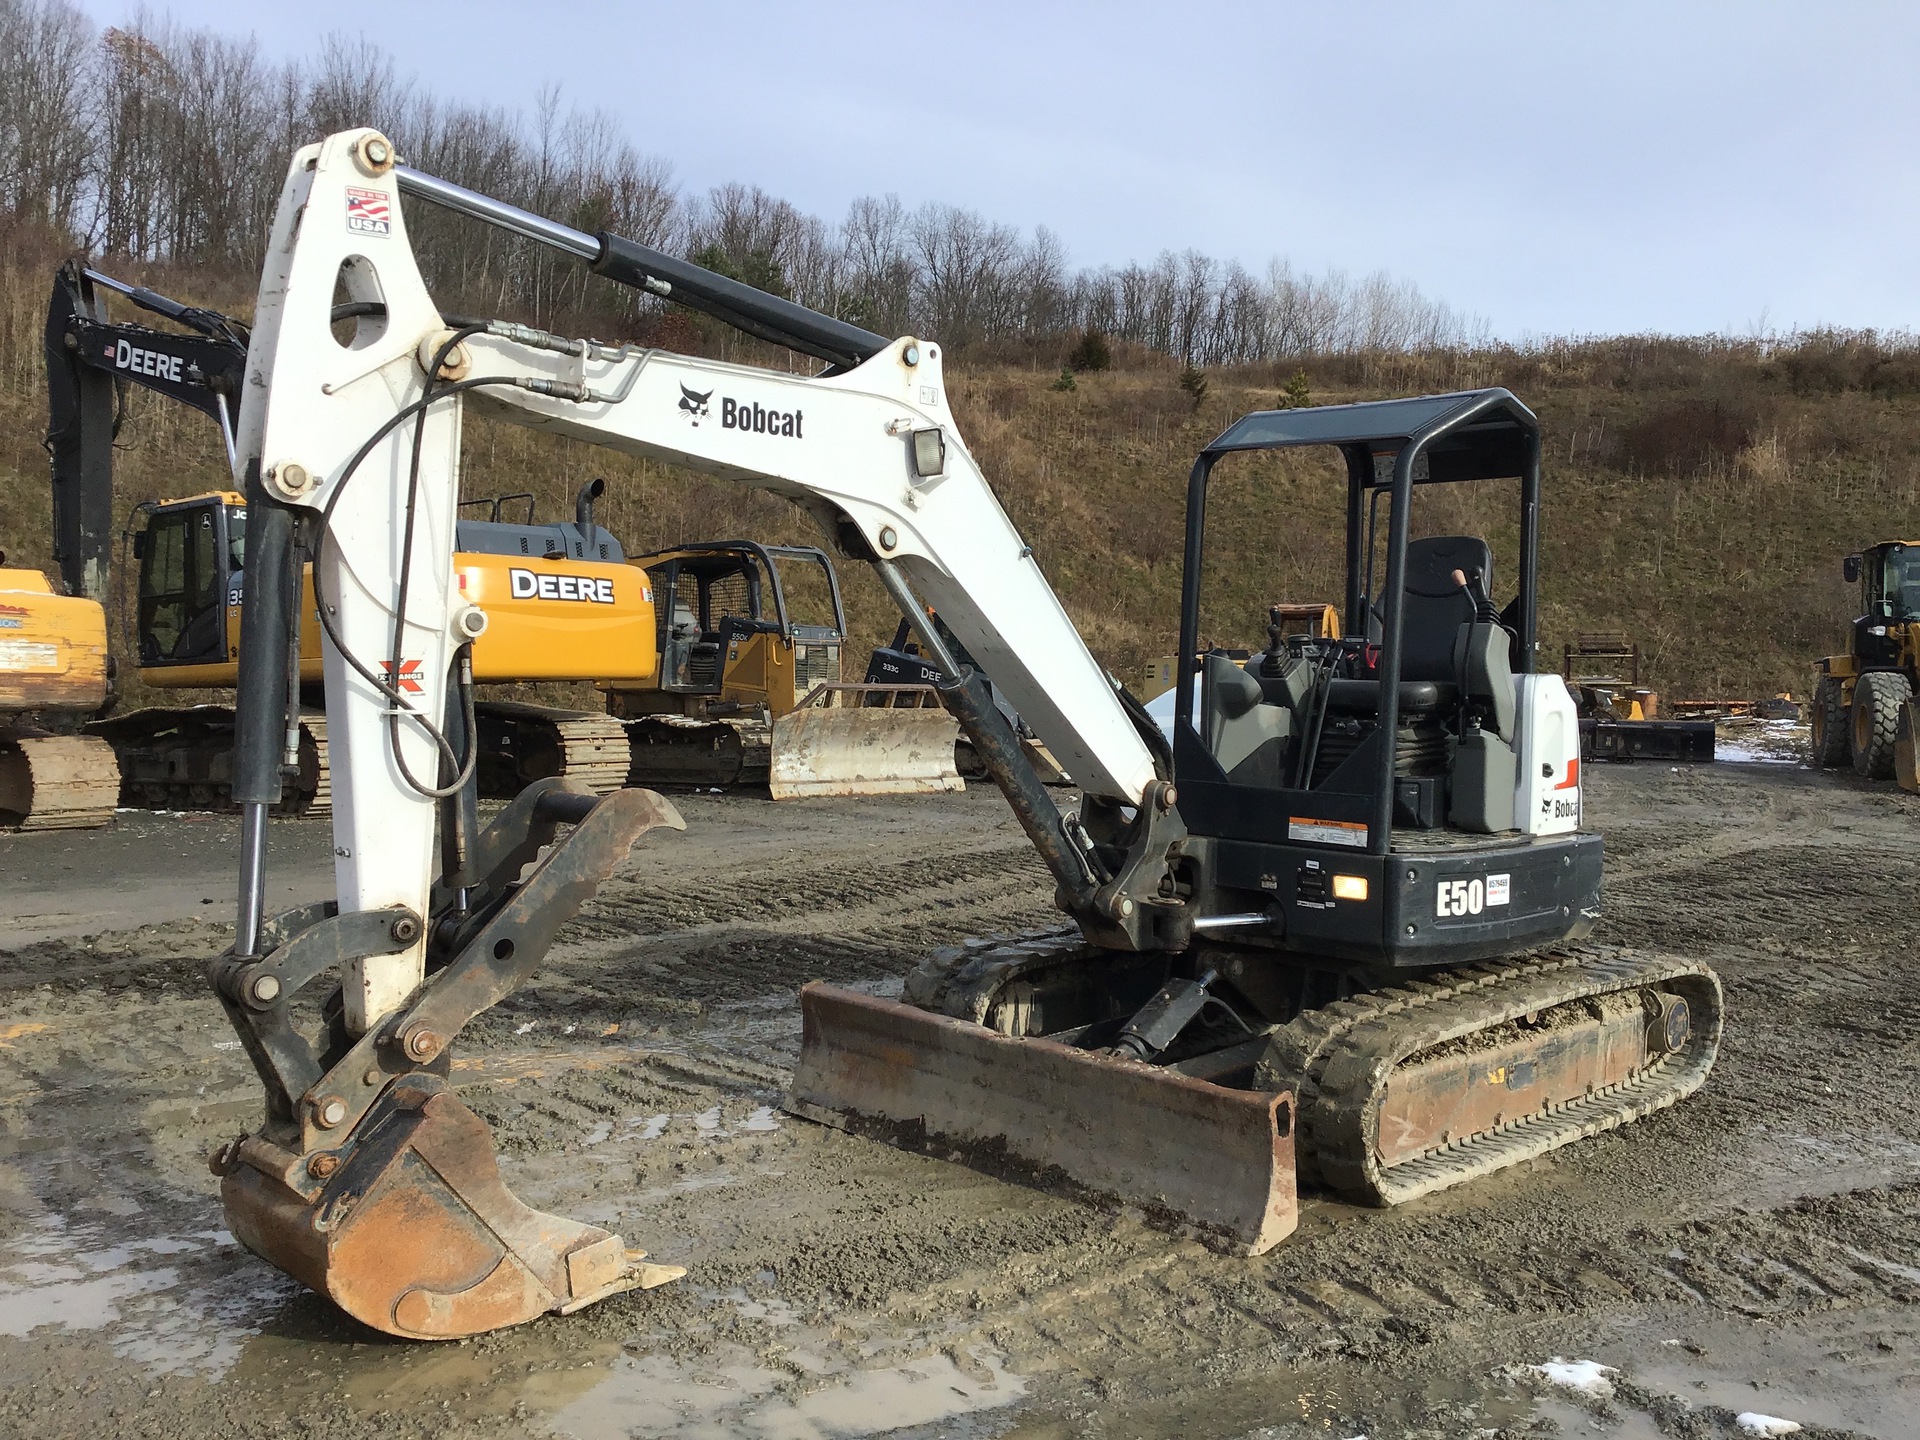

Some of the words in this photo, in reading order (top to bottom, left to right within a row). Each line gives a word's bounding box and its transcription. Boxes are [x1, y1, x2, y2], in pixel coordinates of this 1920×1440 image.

[350, 218, 388, 233] USA
[116, 339, 184, 383] DEERE
[722, 397, 803, 439] Bobcat
[509, 568, 615, 604] DEERE
[1437, 879, 1484, 917] E50
